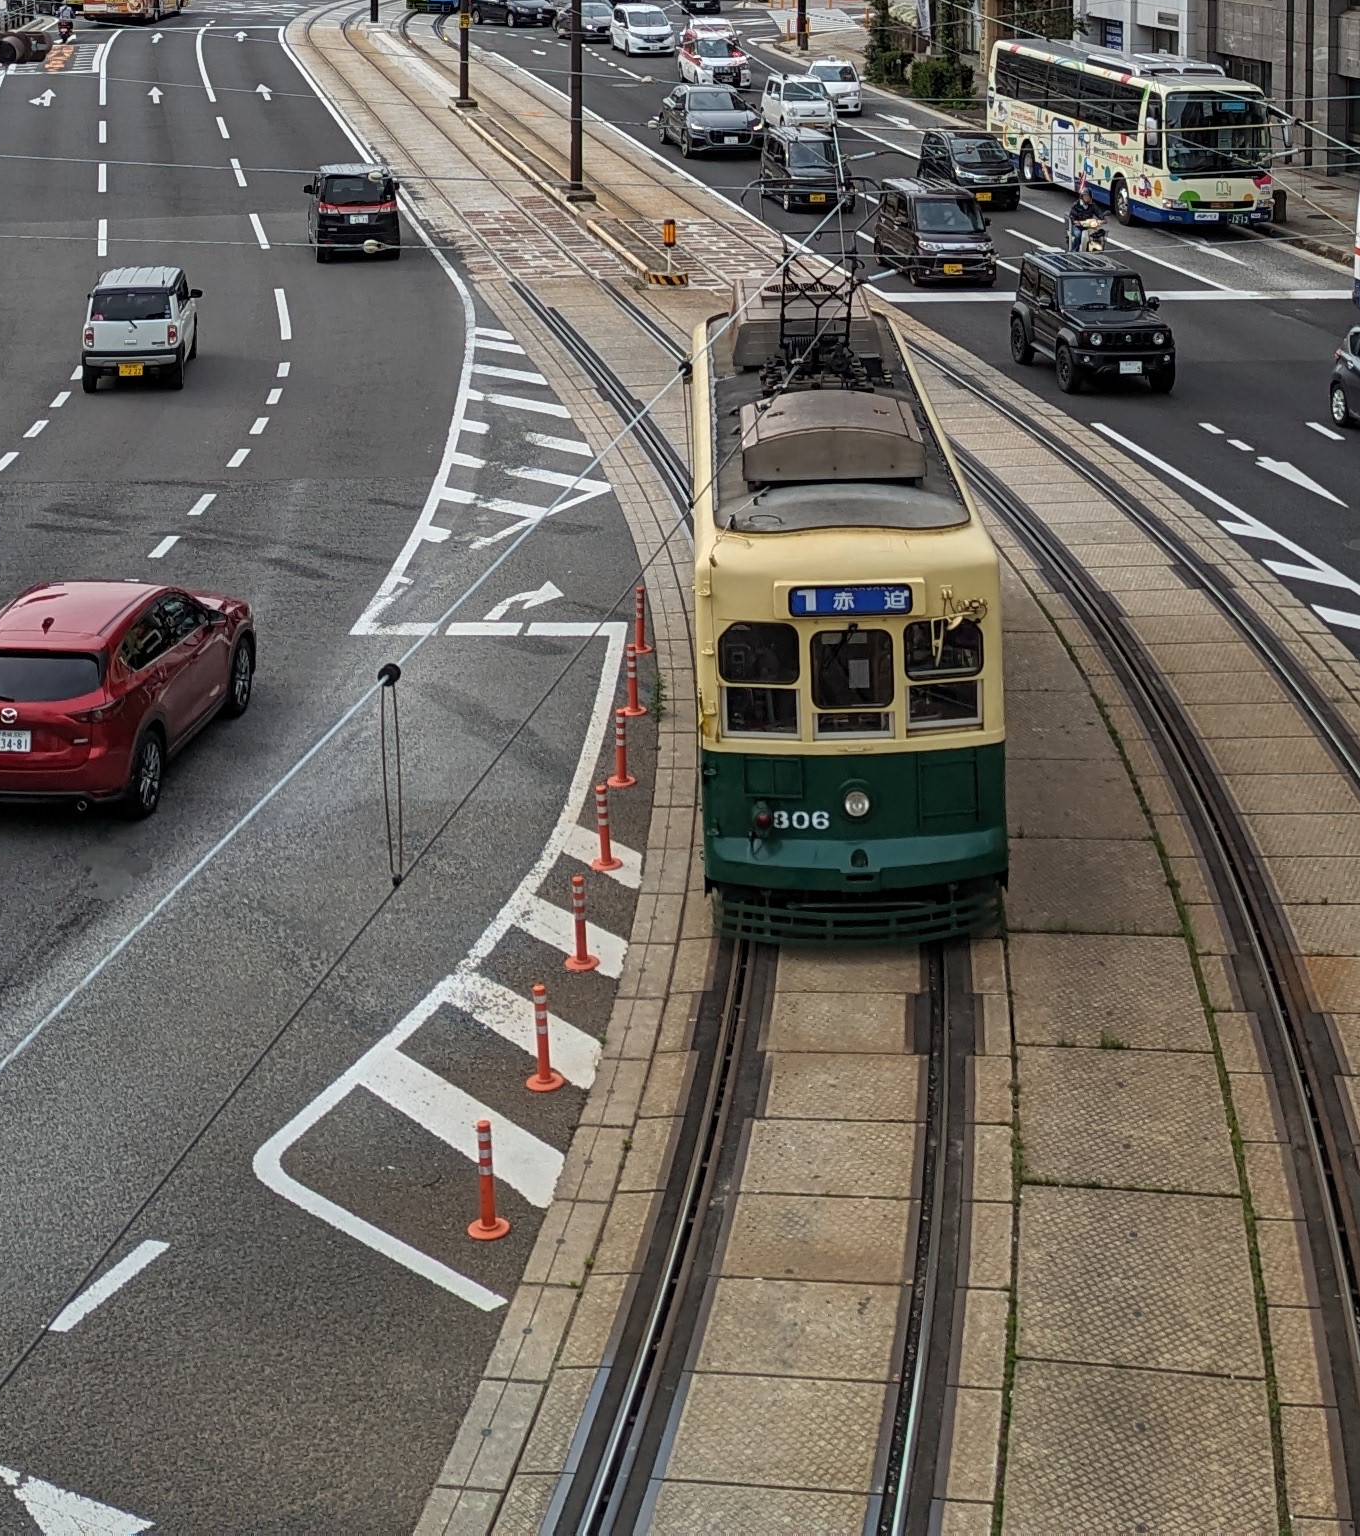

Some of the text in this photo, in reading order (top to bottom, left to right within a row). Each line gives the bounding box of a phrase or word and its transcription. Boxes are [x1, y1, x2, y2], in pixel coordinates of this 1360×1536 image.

[796, 589, 910, 612] 1 赤迫
[0, 738, 28, 750] 34-81
